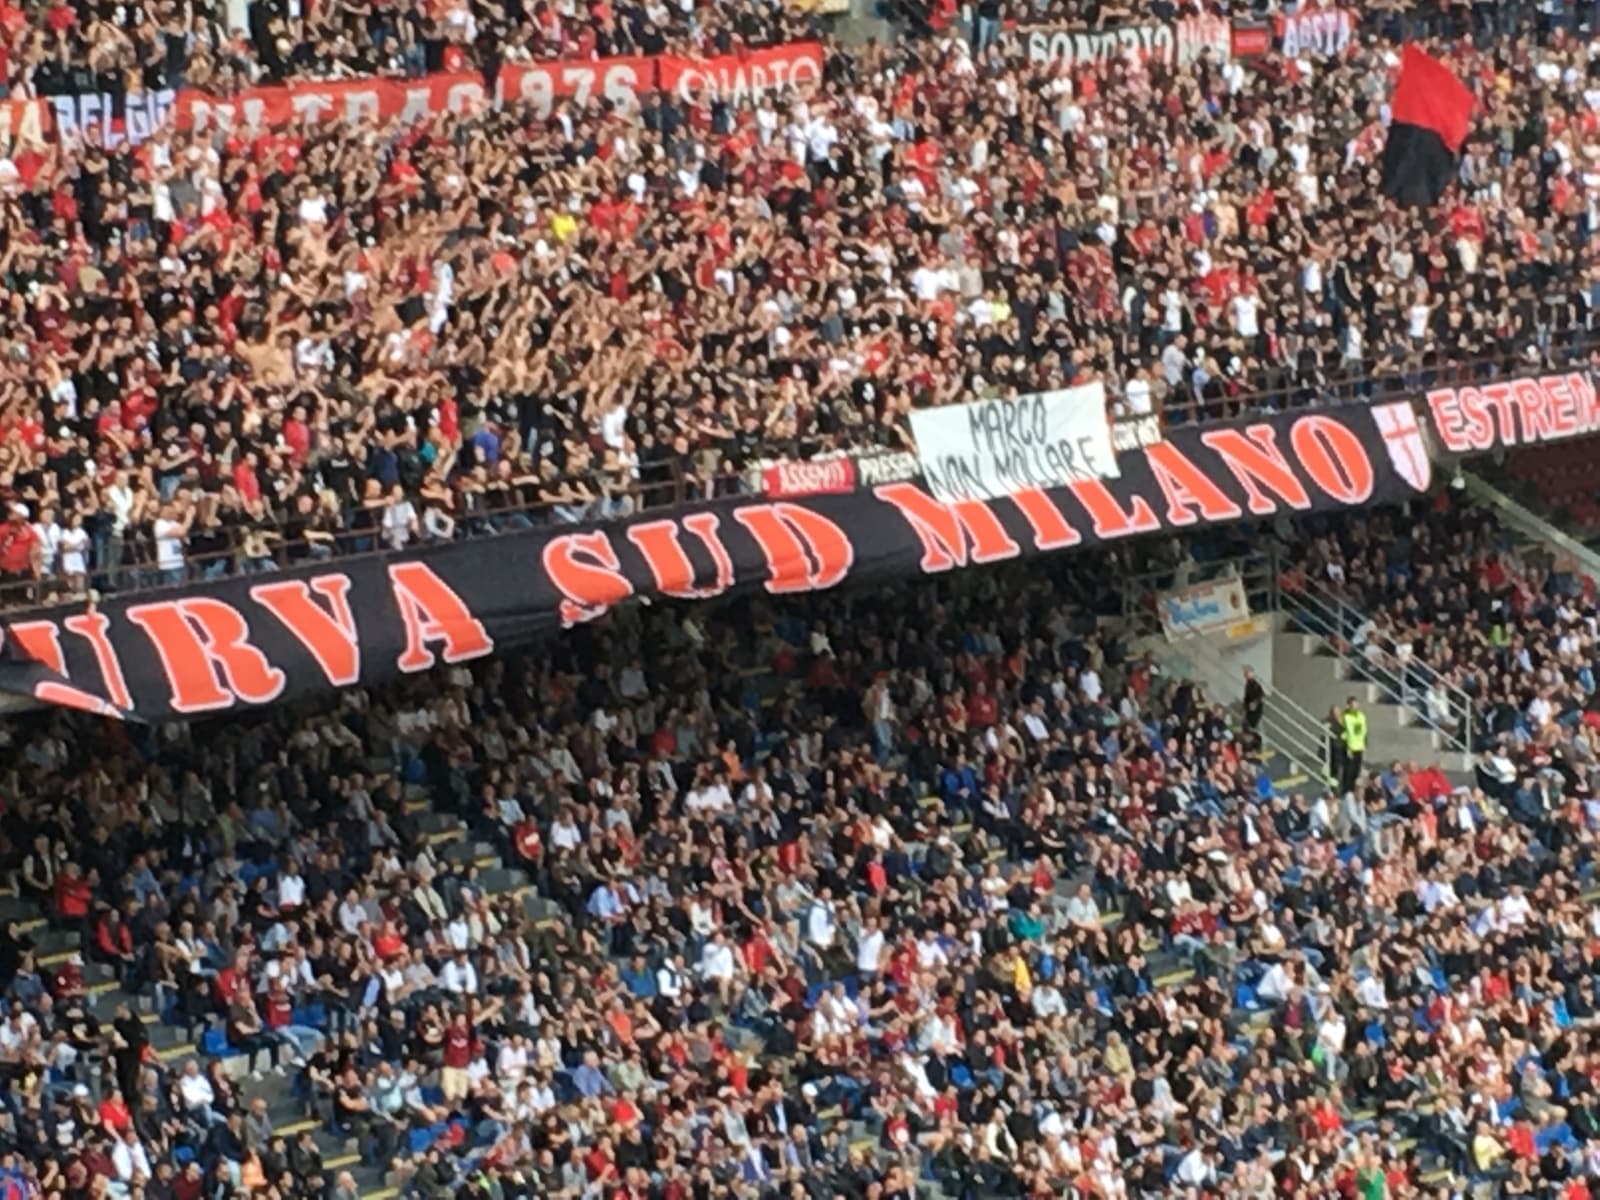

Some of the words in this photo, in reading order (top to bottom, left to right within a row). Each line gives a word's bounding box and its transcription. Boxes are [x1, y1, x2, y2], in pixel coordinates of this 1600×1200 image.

[967, 395, 1048, 453] MARCO
[925, 454, 996, 501] NON
[542, 502, 854, 629] SUD
[874, 415, 1375, 573] MILANO
